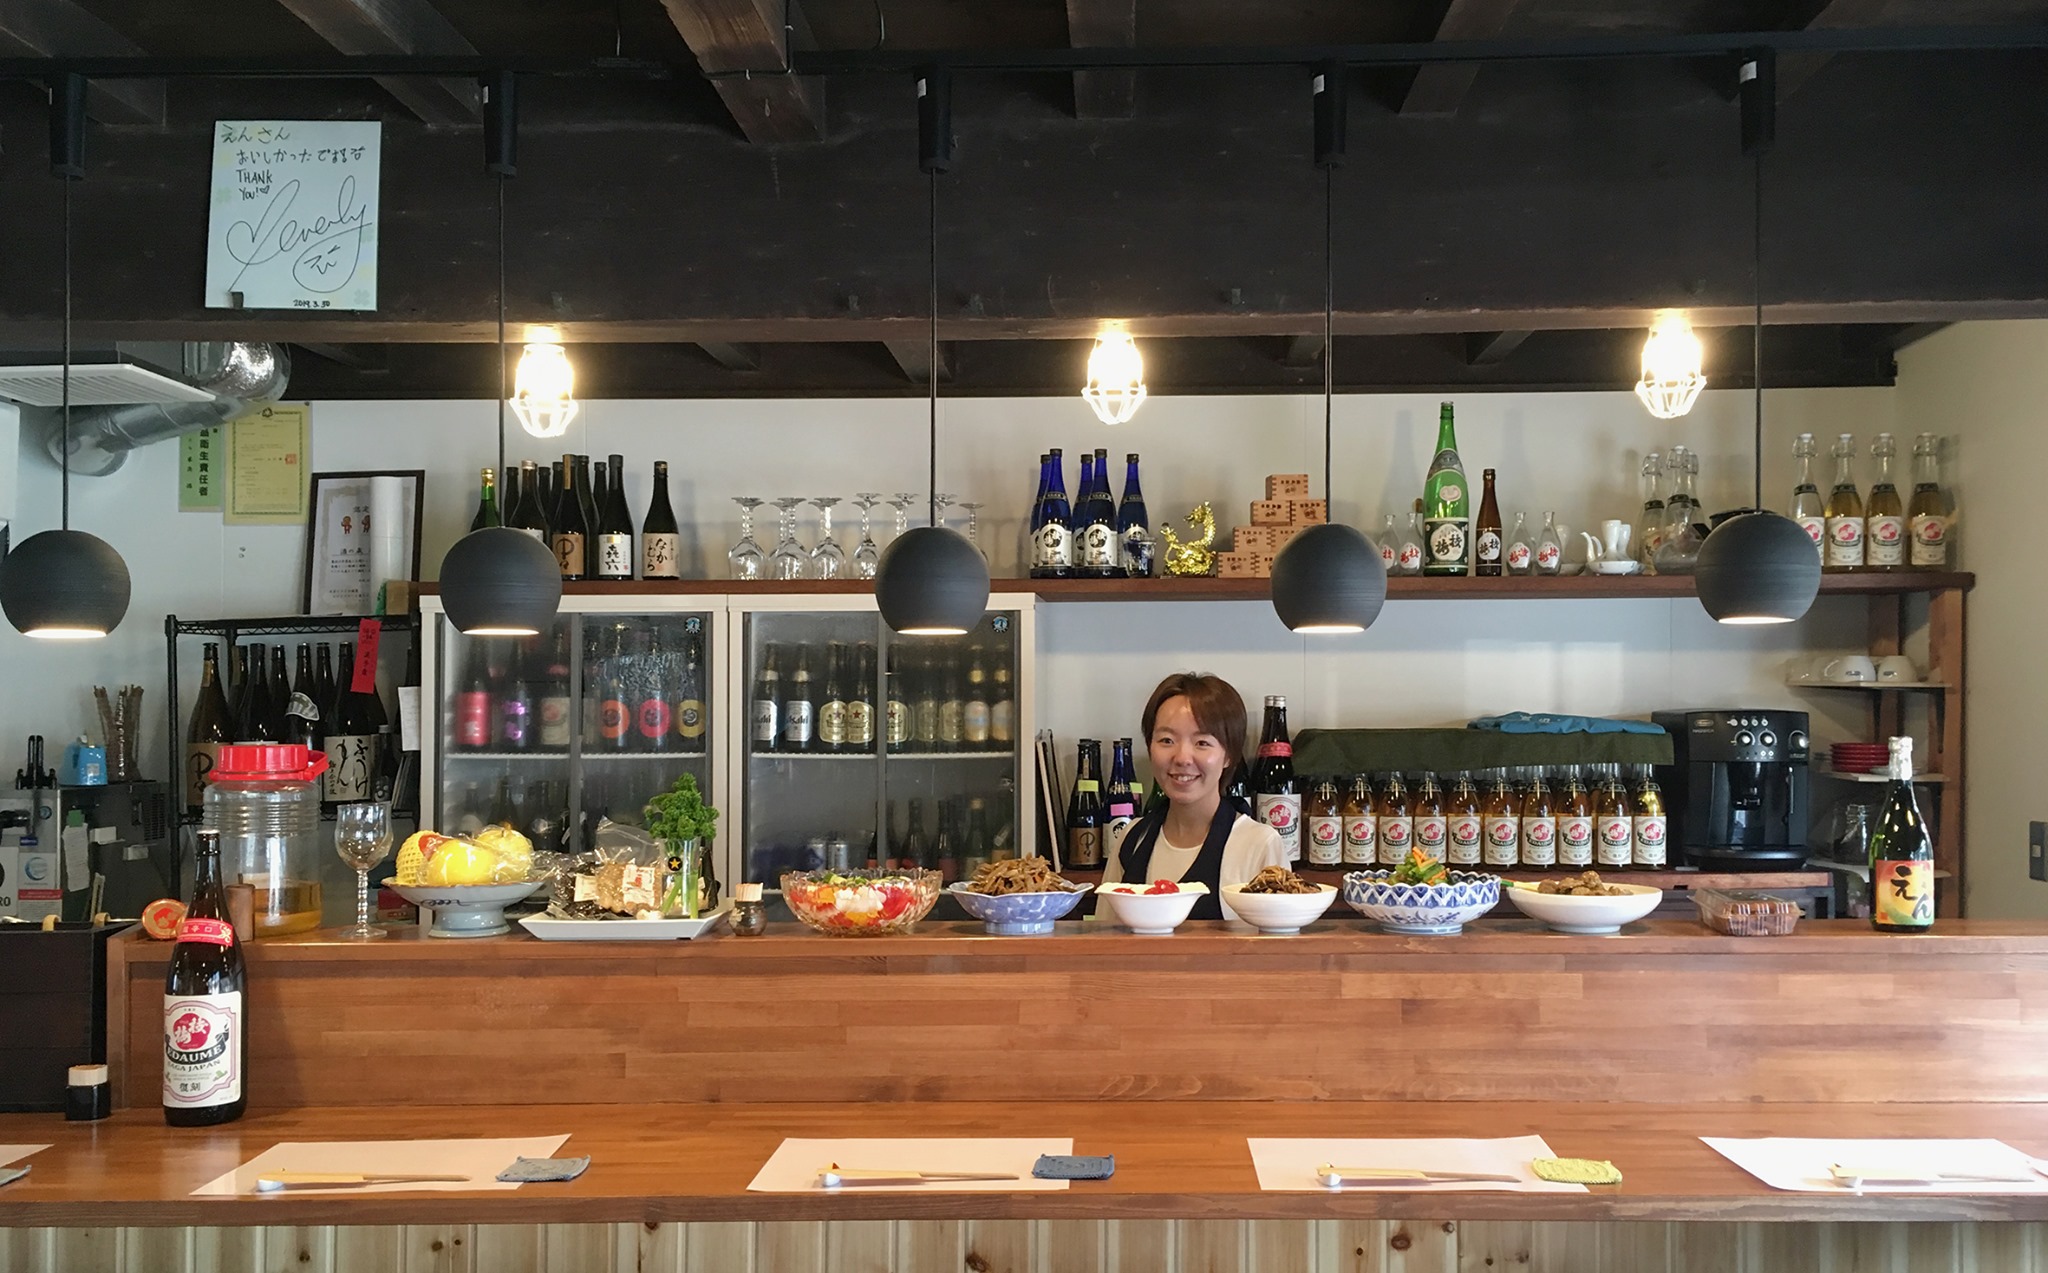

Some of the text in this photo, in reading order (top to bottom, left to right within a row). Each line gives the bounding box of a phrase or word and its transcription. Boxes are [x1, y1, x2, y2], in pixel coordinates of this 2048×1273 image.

[236, 169, 272, 184] THANK
[1890, 865, 1932, 920] えん
[188, 1059, 221, 1072] JAPAN
